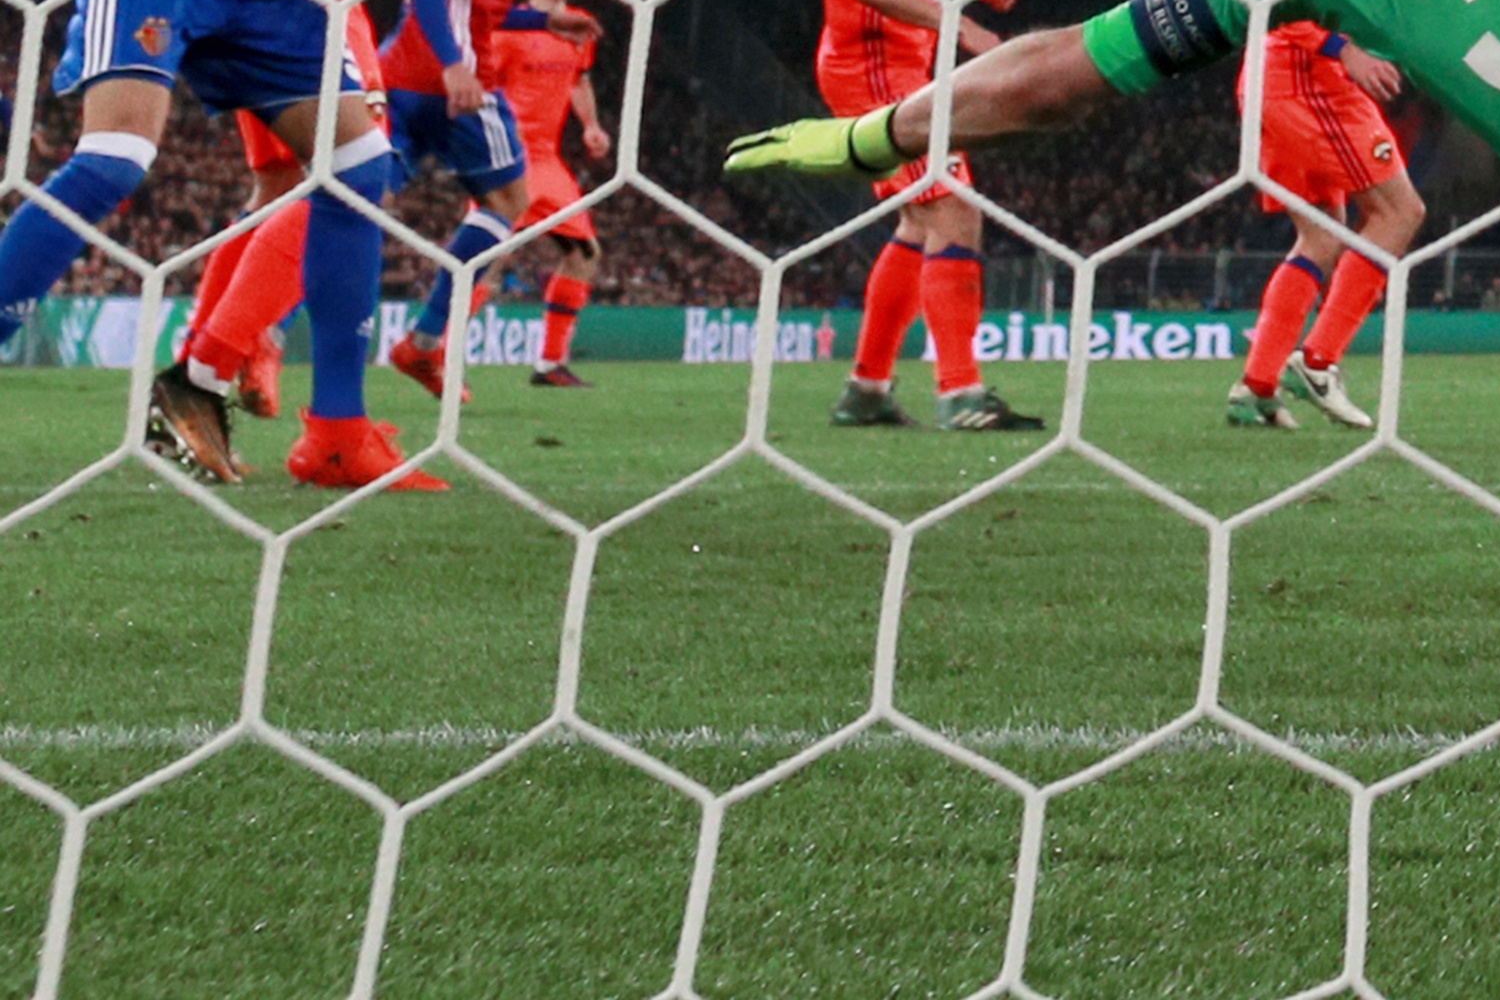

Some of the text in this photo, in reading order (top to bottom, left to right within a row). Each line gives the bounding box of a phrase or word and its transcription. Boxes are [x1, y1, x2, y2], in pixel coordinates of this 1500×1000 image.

[374, 302, 546, 365] Heken
[682, 307, 813, 363] Heinen
[921, 311, 1234, 362] eineken
